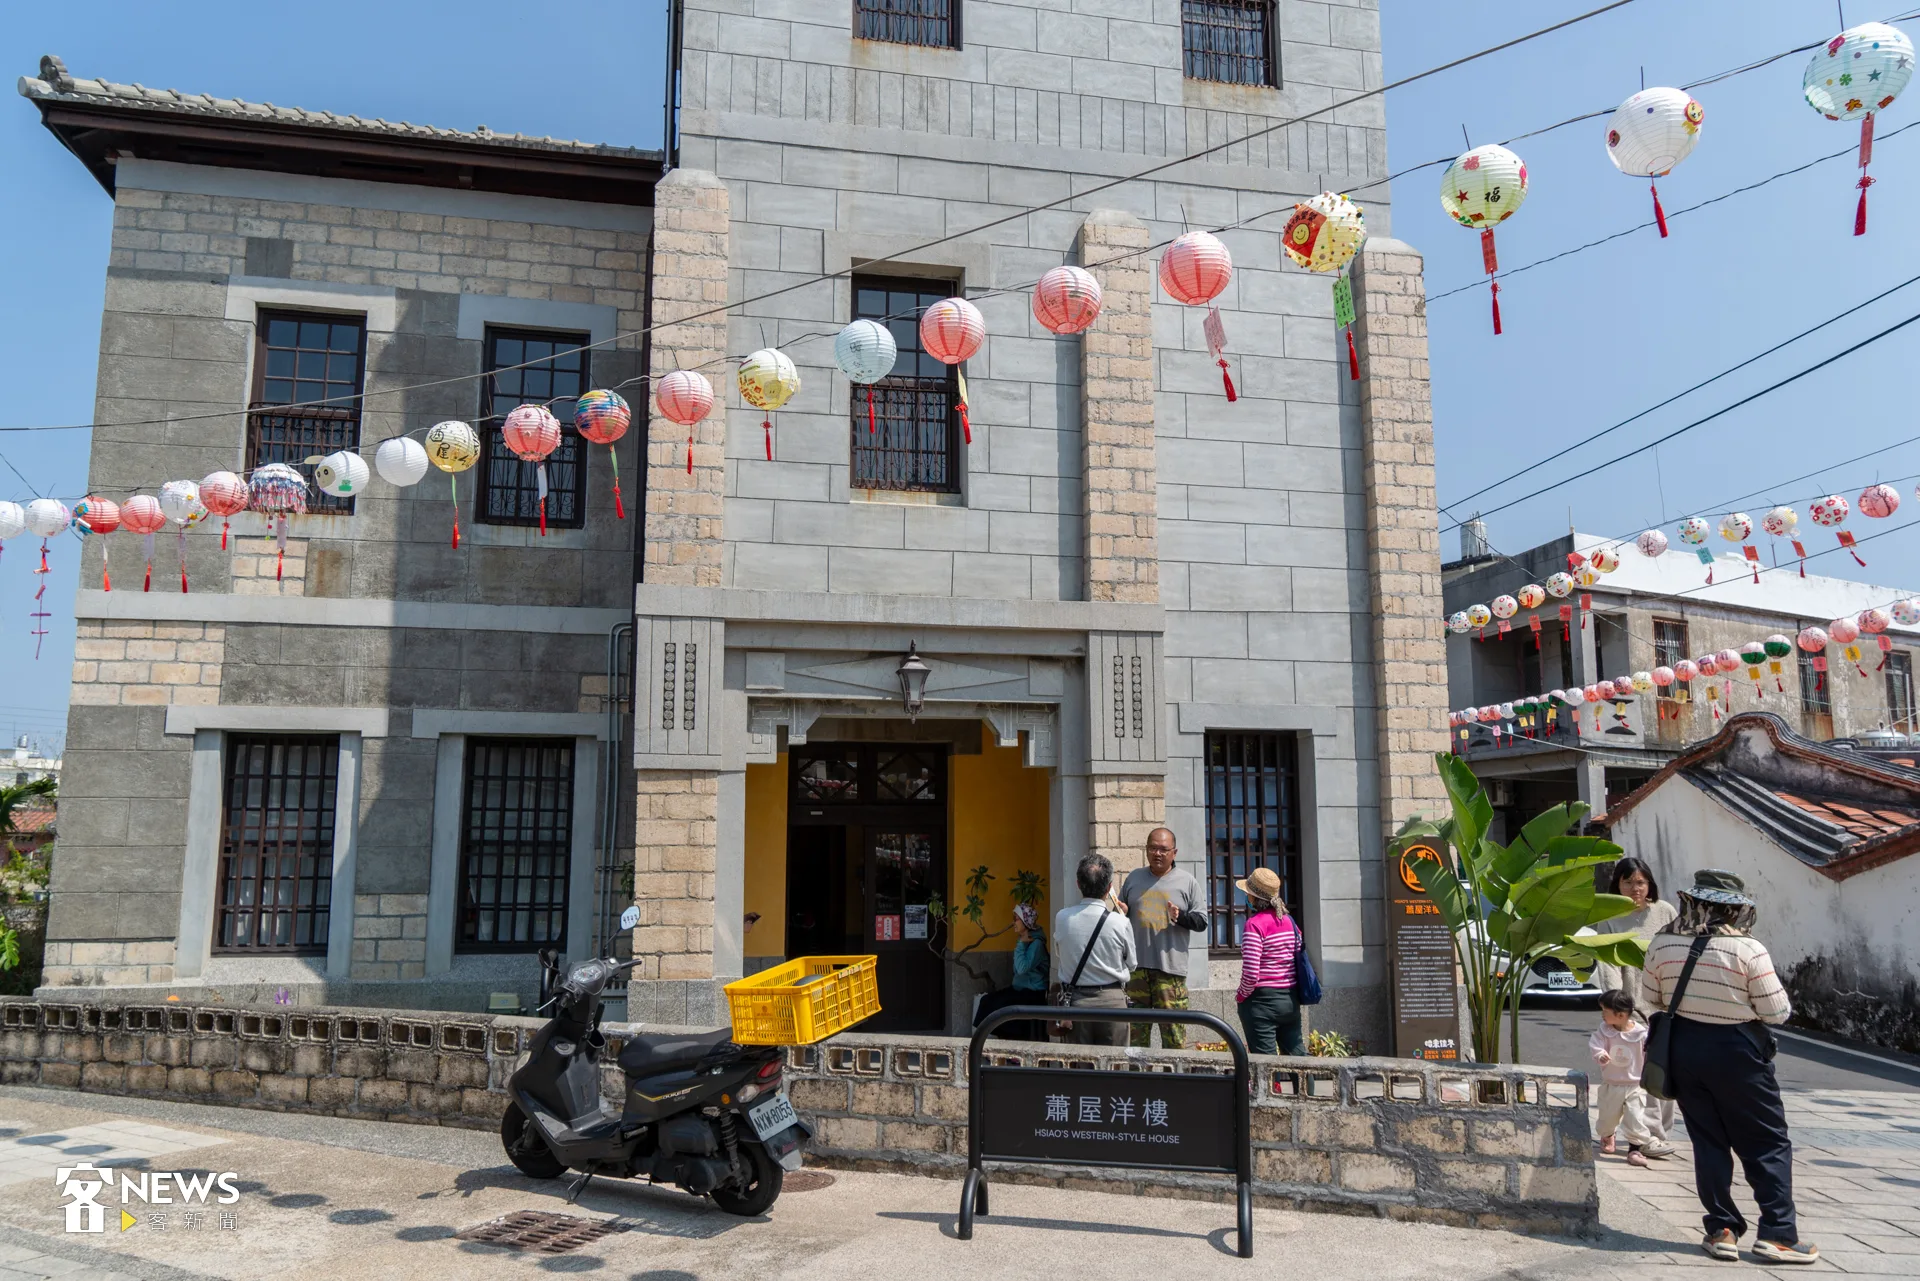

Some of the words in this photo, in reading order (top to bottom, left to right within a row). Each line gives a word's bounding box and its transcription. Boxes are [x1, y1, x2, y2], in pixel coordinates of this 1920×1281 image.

[1484, 186, 1501, 202] 福
[753, 1101, 793, 1133] NXW-8053
[1045, 1094, 1169, 1127] 蕭屋洋樓
[1034, 1128, 1069, 1139] HSIAO'S
[1071, 1130, 1146, 1143] WESTERN-STYLE
[1148, 1134, 1180, 1144] HOUSE
